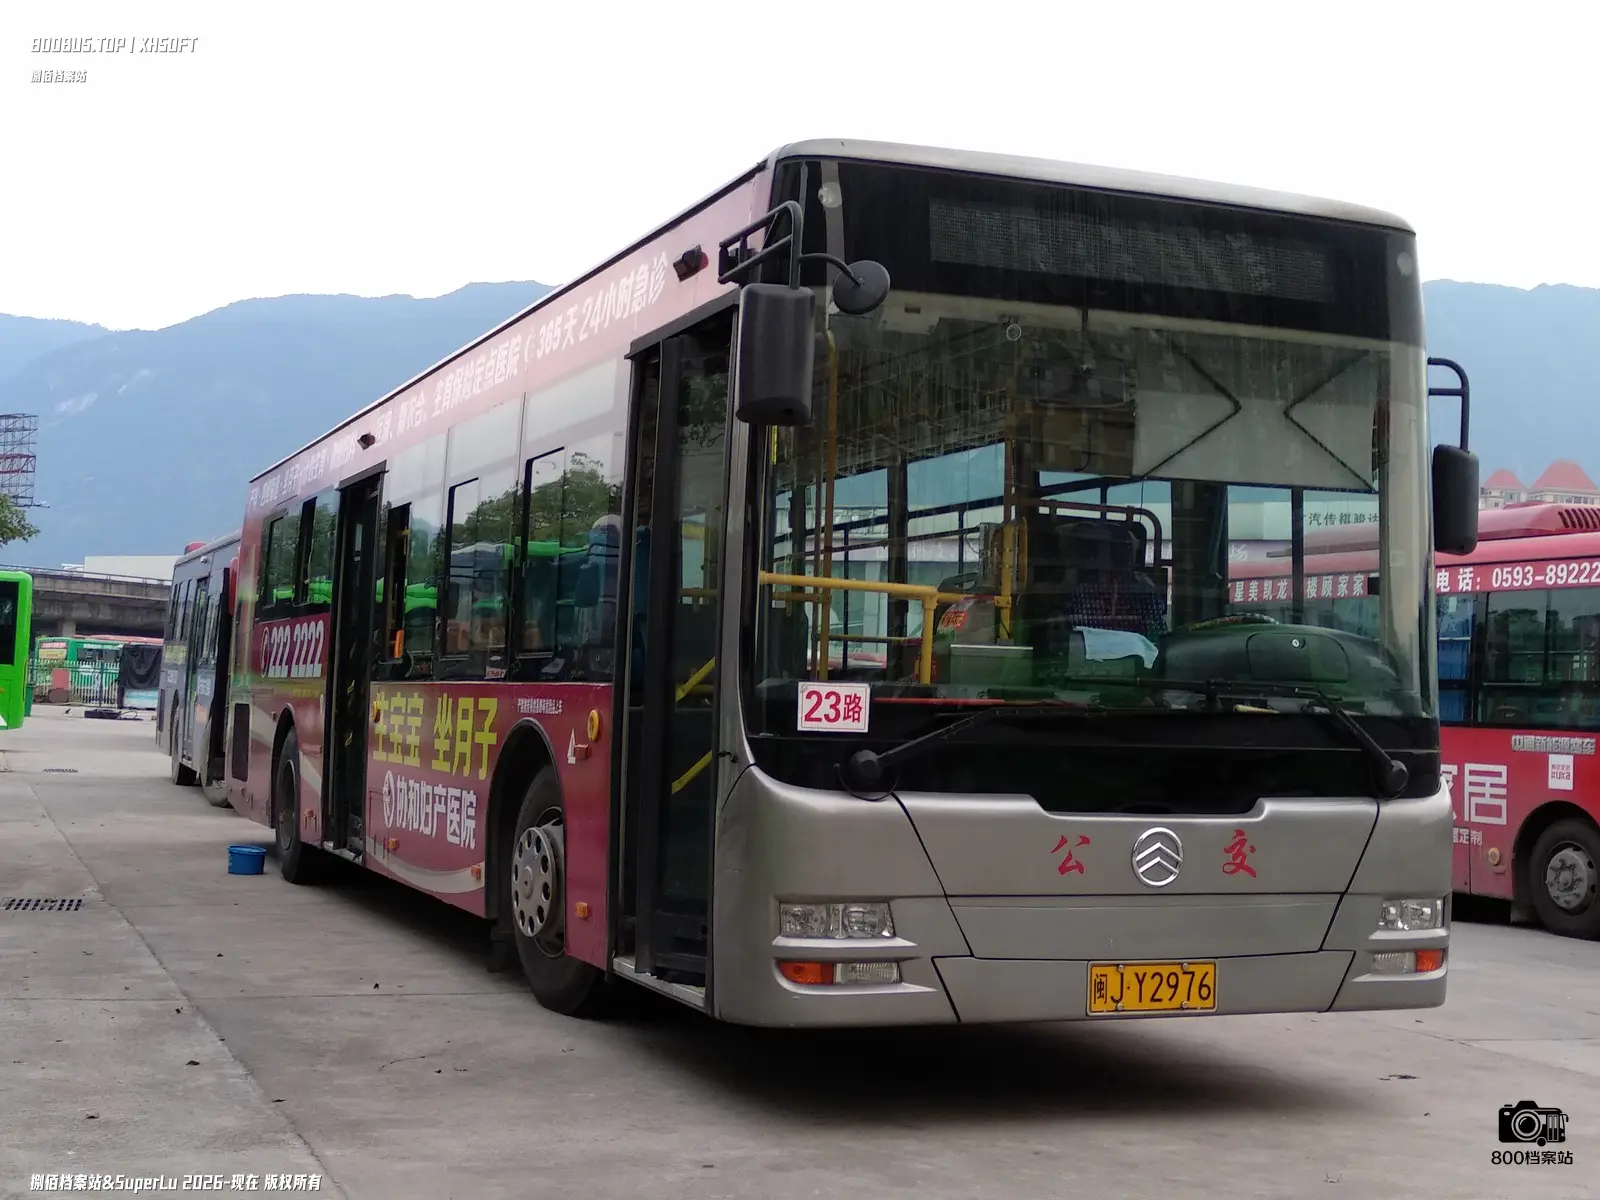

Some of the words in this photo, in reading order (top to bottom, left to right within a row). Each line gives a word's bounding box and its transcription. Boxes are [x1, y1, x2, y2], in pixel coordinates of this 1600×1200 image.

[536, 304, 579, 360] 365天
[578, 251, 669, 342] 24小时急诊
[268, 624, 291, 678] 222
[290, 619, 324, 678] 2222
[431, 693, 499, 781] 坐月子
[804, 690, 863, 723] 23路
[396, 775, 477, 850] 协和妇产医院
[1051, 834, 1091, 876] 公
[1222, 829, 1257, 878] 交
